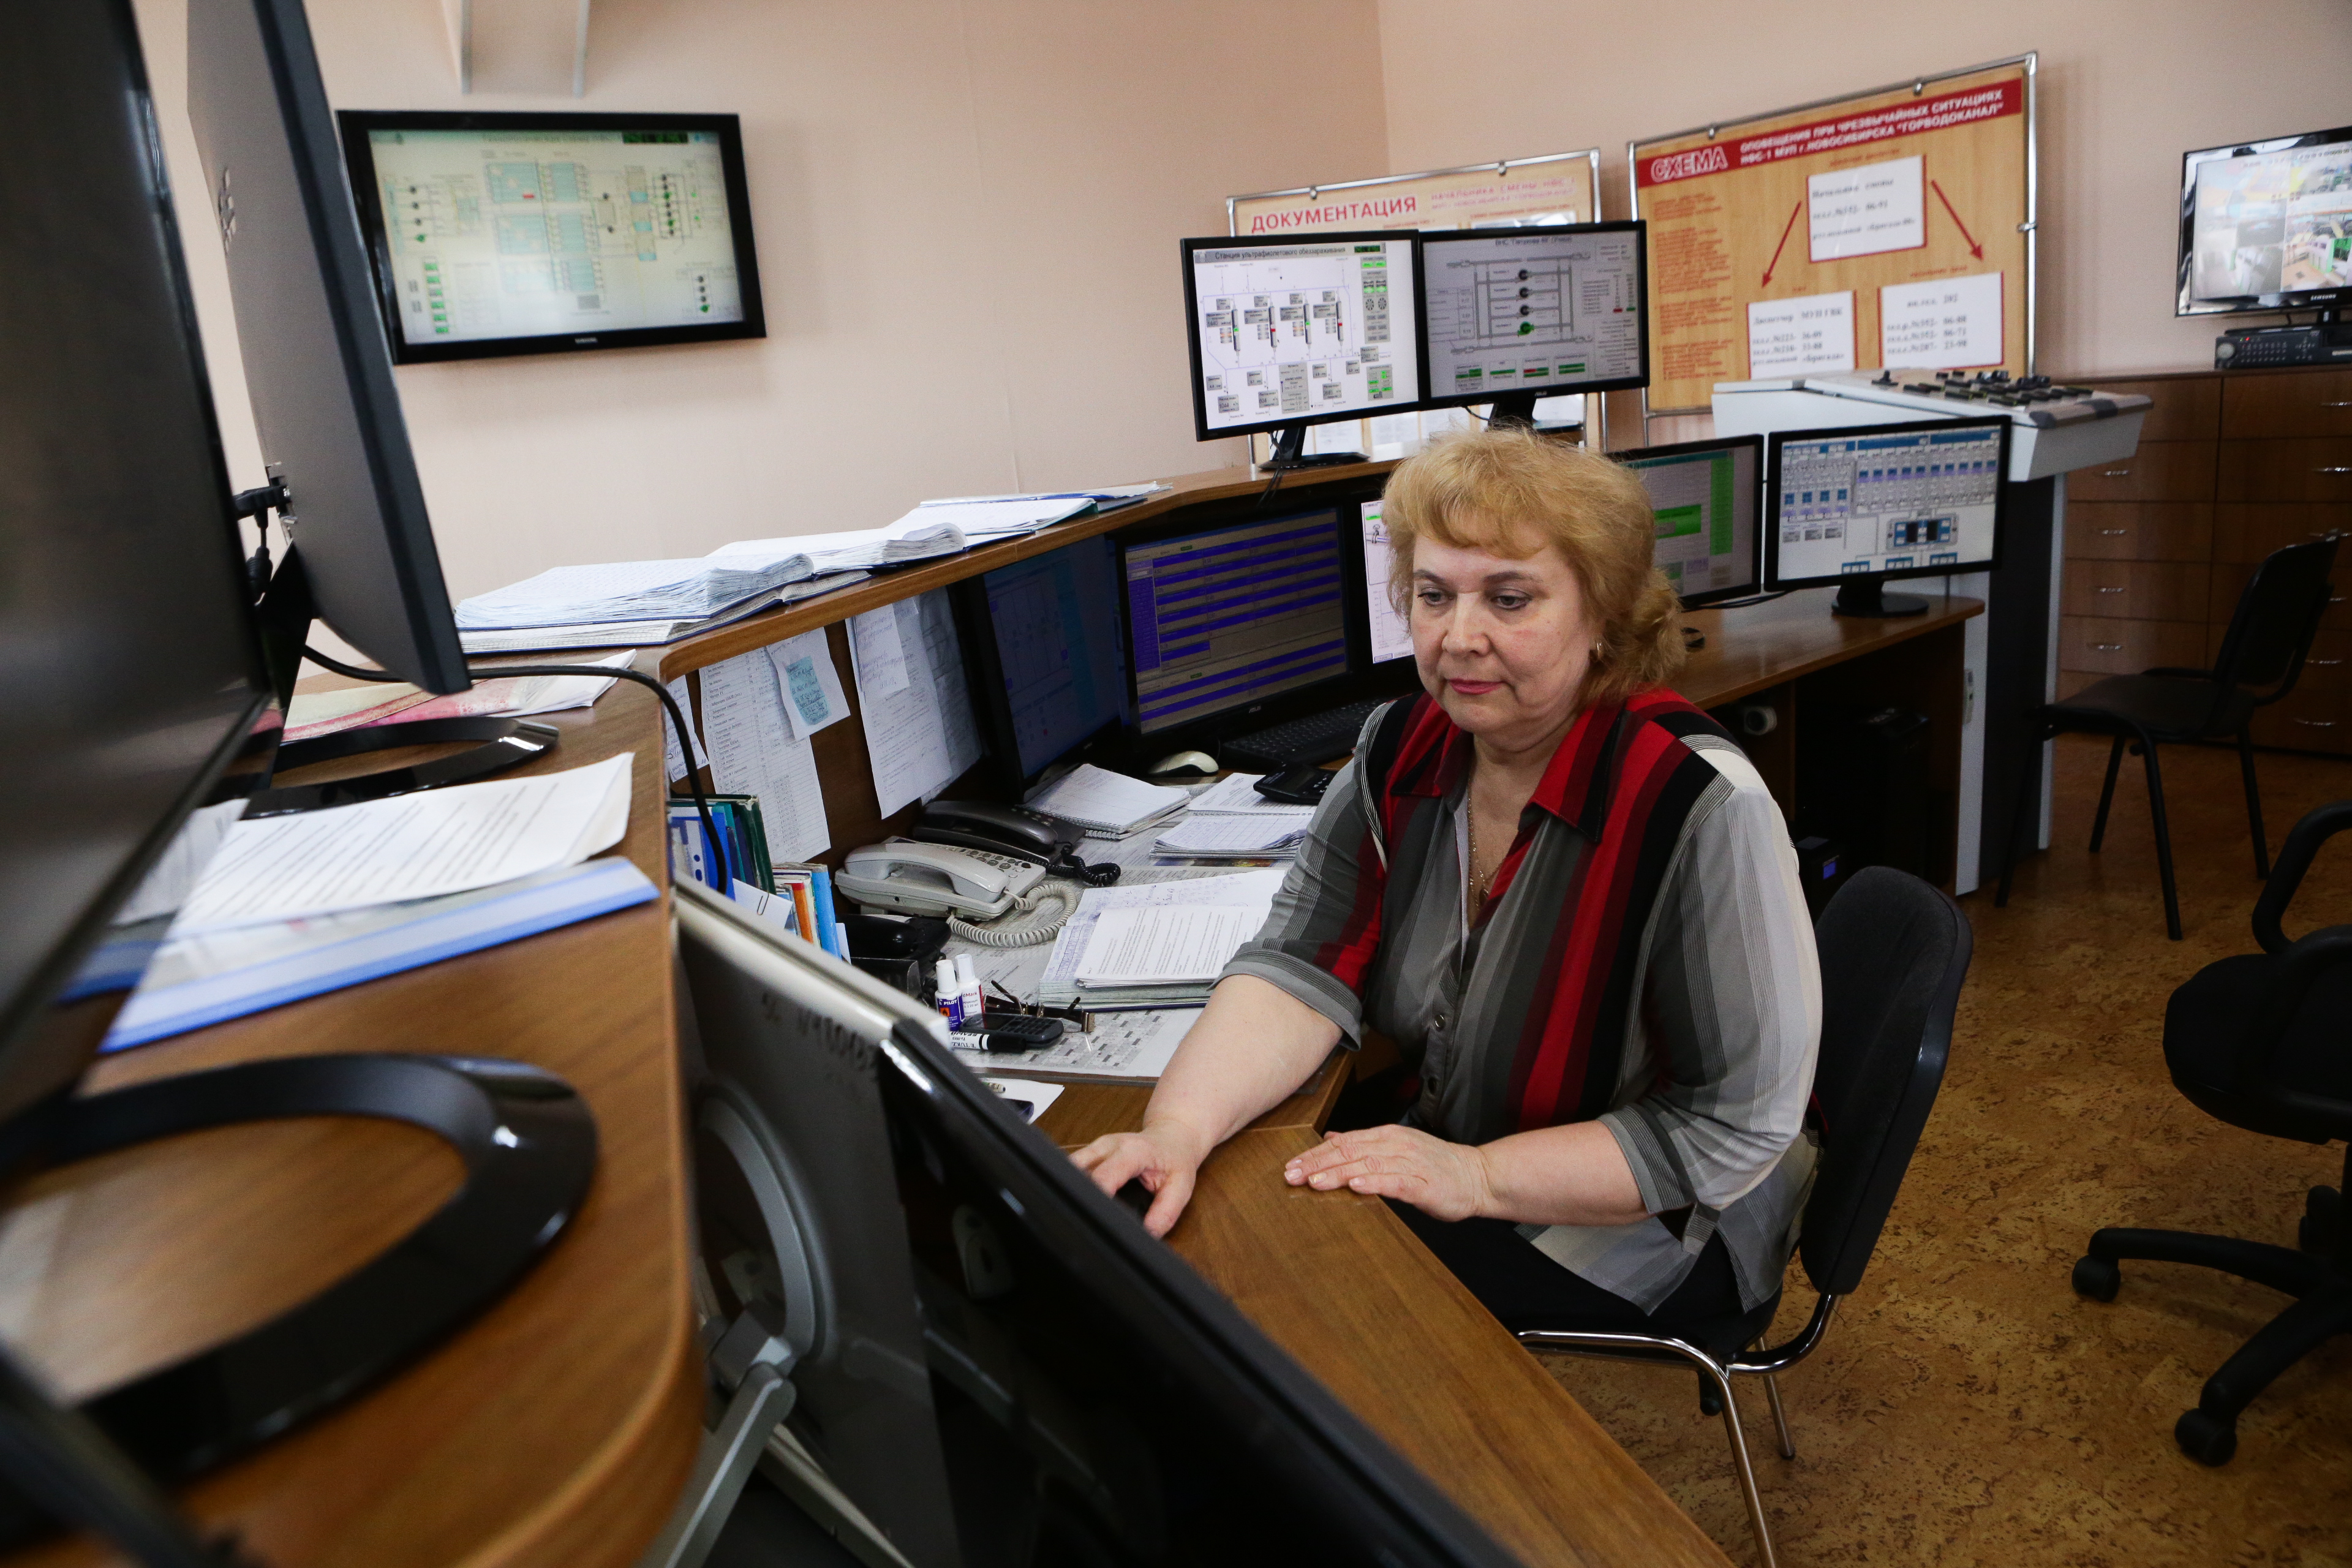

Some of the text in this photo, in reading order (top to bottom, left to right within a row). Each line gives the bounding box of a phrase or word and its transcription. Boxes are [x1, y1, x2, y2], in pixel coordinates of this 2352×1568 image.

[1813, 124, 1836, 138] ПРИ
[1931, 89, 2003, 115] СИТУАЦИЯХ
[1651, 146, 1728, 183] СХЕМА
[1251, 197, 1417, 234] ДОКУМЕНТАЦИЯ
[1242, 249, 1297, 260] ультрафиолетового
